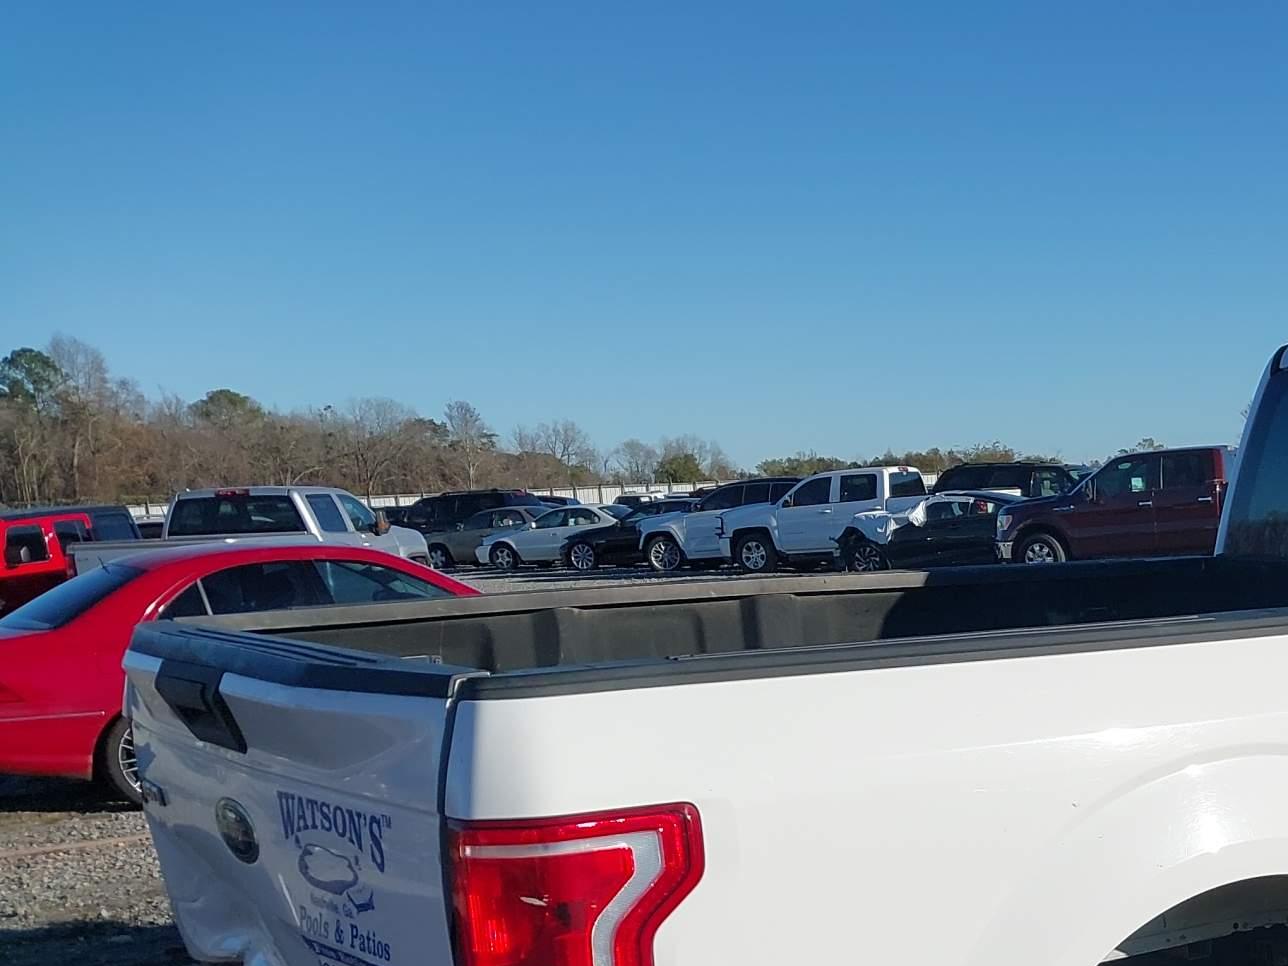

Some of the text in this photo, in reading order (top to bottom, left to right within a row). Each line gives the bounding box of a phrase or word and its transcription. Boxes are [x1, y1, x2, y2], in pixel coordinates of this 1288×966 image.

[276, 790, 386, 874] WATSON'S
[299, 905, 330, 940] Pools
[334, 919, 345, 945] &
[349, 922, 391, 962] Patios
